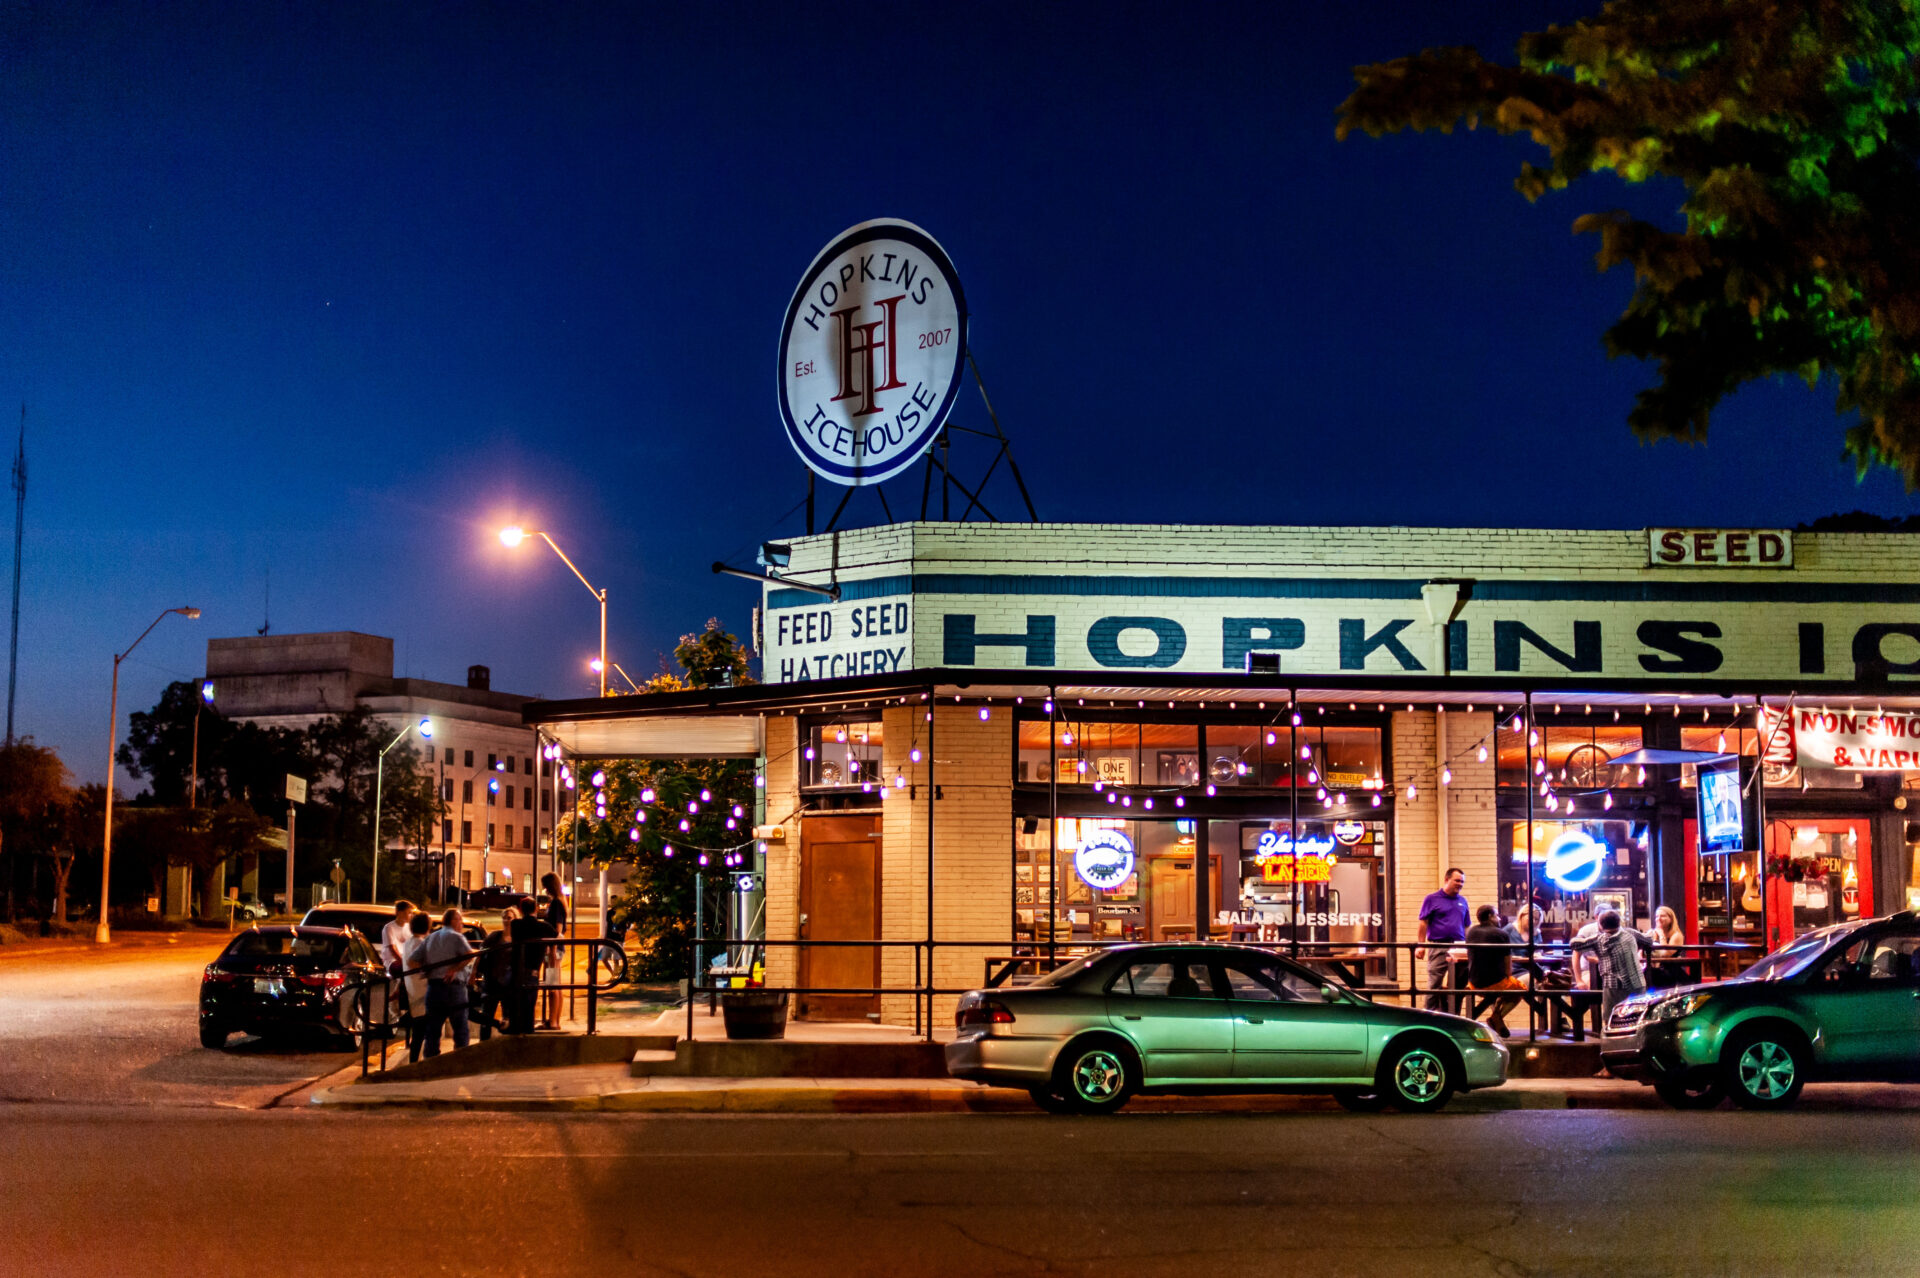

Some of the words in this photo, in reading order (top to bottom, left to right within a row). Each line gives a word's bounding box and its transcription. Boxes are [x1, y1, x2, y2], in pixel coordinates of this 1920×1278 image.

[804, 253, 934, 331] HOPKINS
[794, 360, 817, 378] Est.
[918, 328, 951, 350] 2007
[804, 381, 937, 457] ICEHOUSE
[1660, 531, 1785, 563] SEED
[778, 611, 832, 646] FEED
[851, 602, 908, 638] SEED
[943, 613, 1723, 673] HOPKINS
[781, 647, 906, 684] HATCHERY
[1762, 706, 1793, 763] NOW
[1834, 746, 1853, 767] &
[1103, 762, 1125, 774] ONE
[1218, 911, 1286, 926] SALADS
[1296, 912, 1382, 926] DESSERTS
